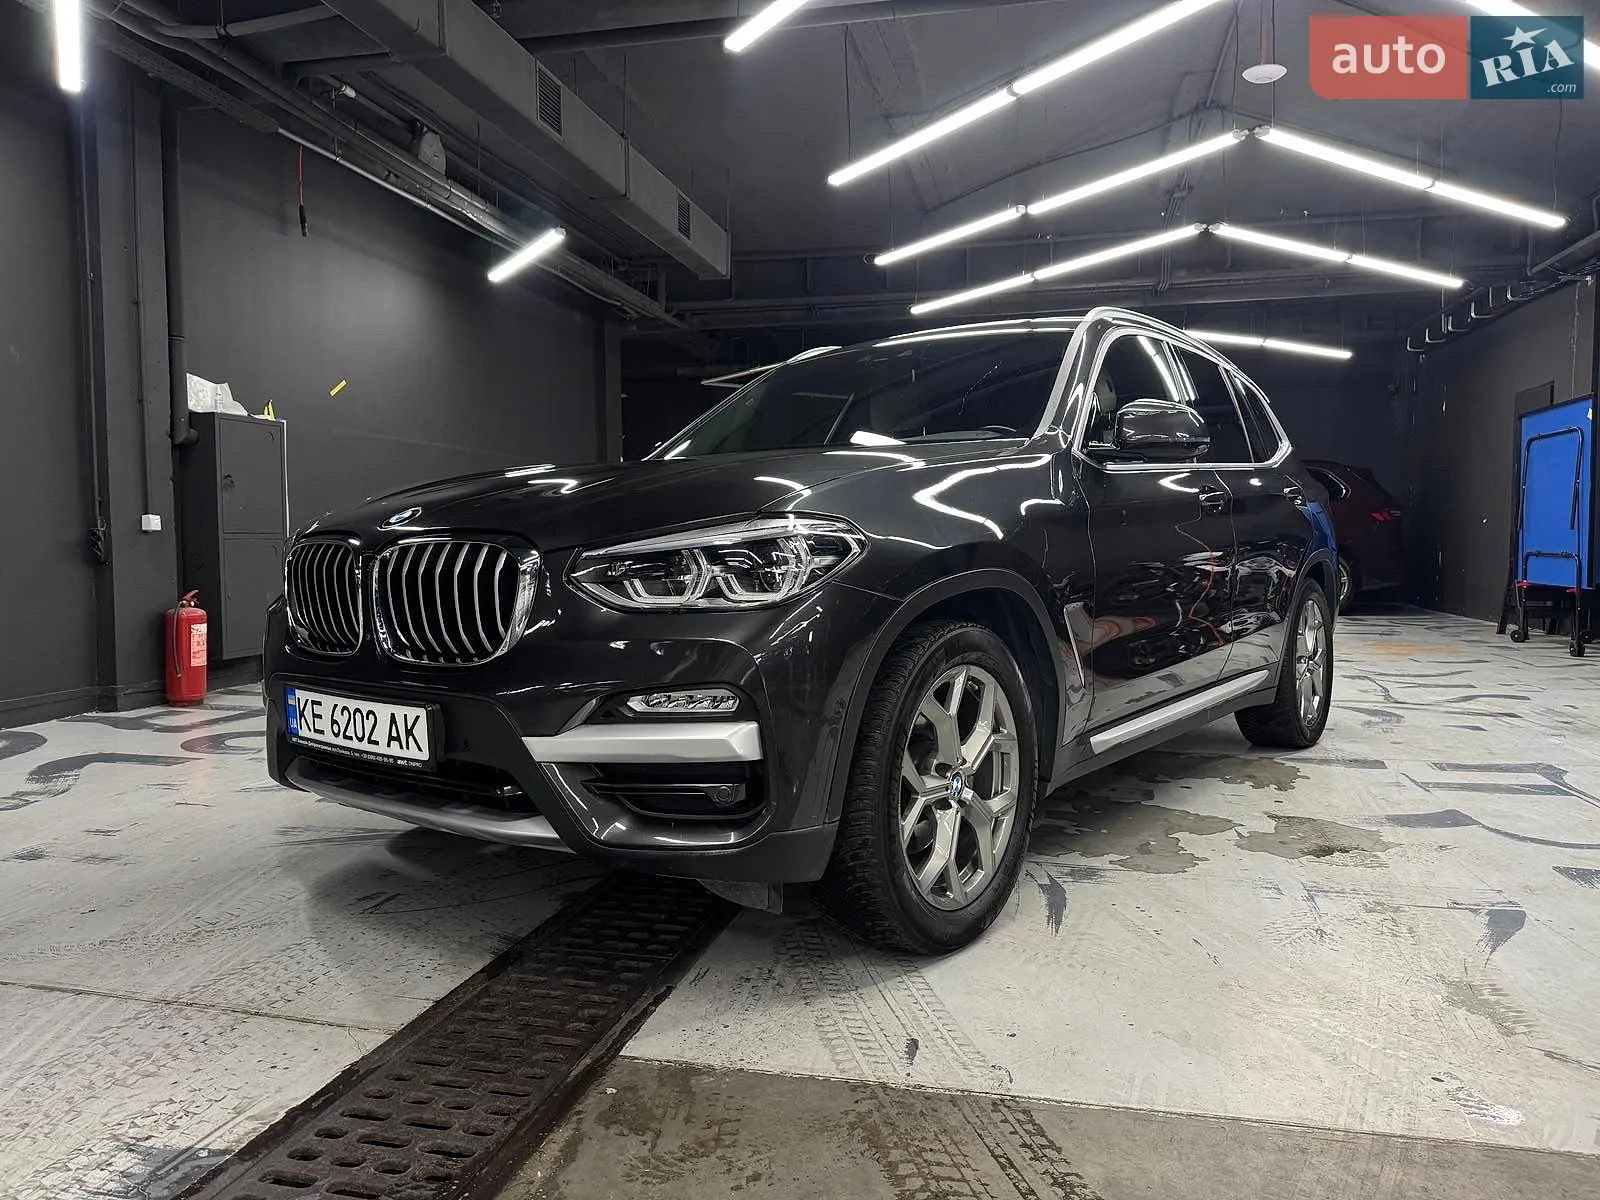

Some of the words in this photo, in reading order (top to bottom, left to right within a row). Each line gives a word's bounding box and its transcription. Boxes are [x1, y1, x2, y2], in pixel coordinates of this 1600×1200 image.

[289, 718, 298, 729] UA
[297, 697, 325, 735] KE
[330, 704, 380, 746] 6202
[386, 712, 424, 753] AK
